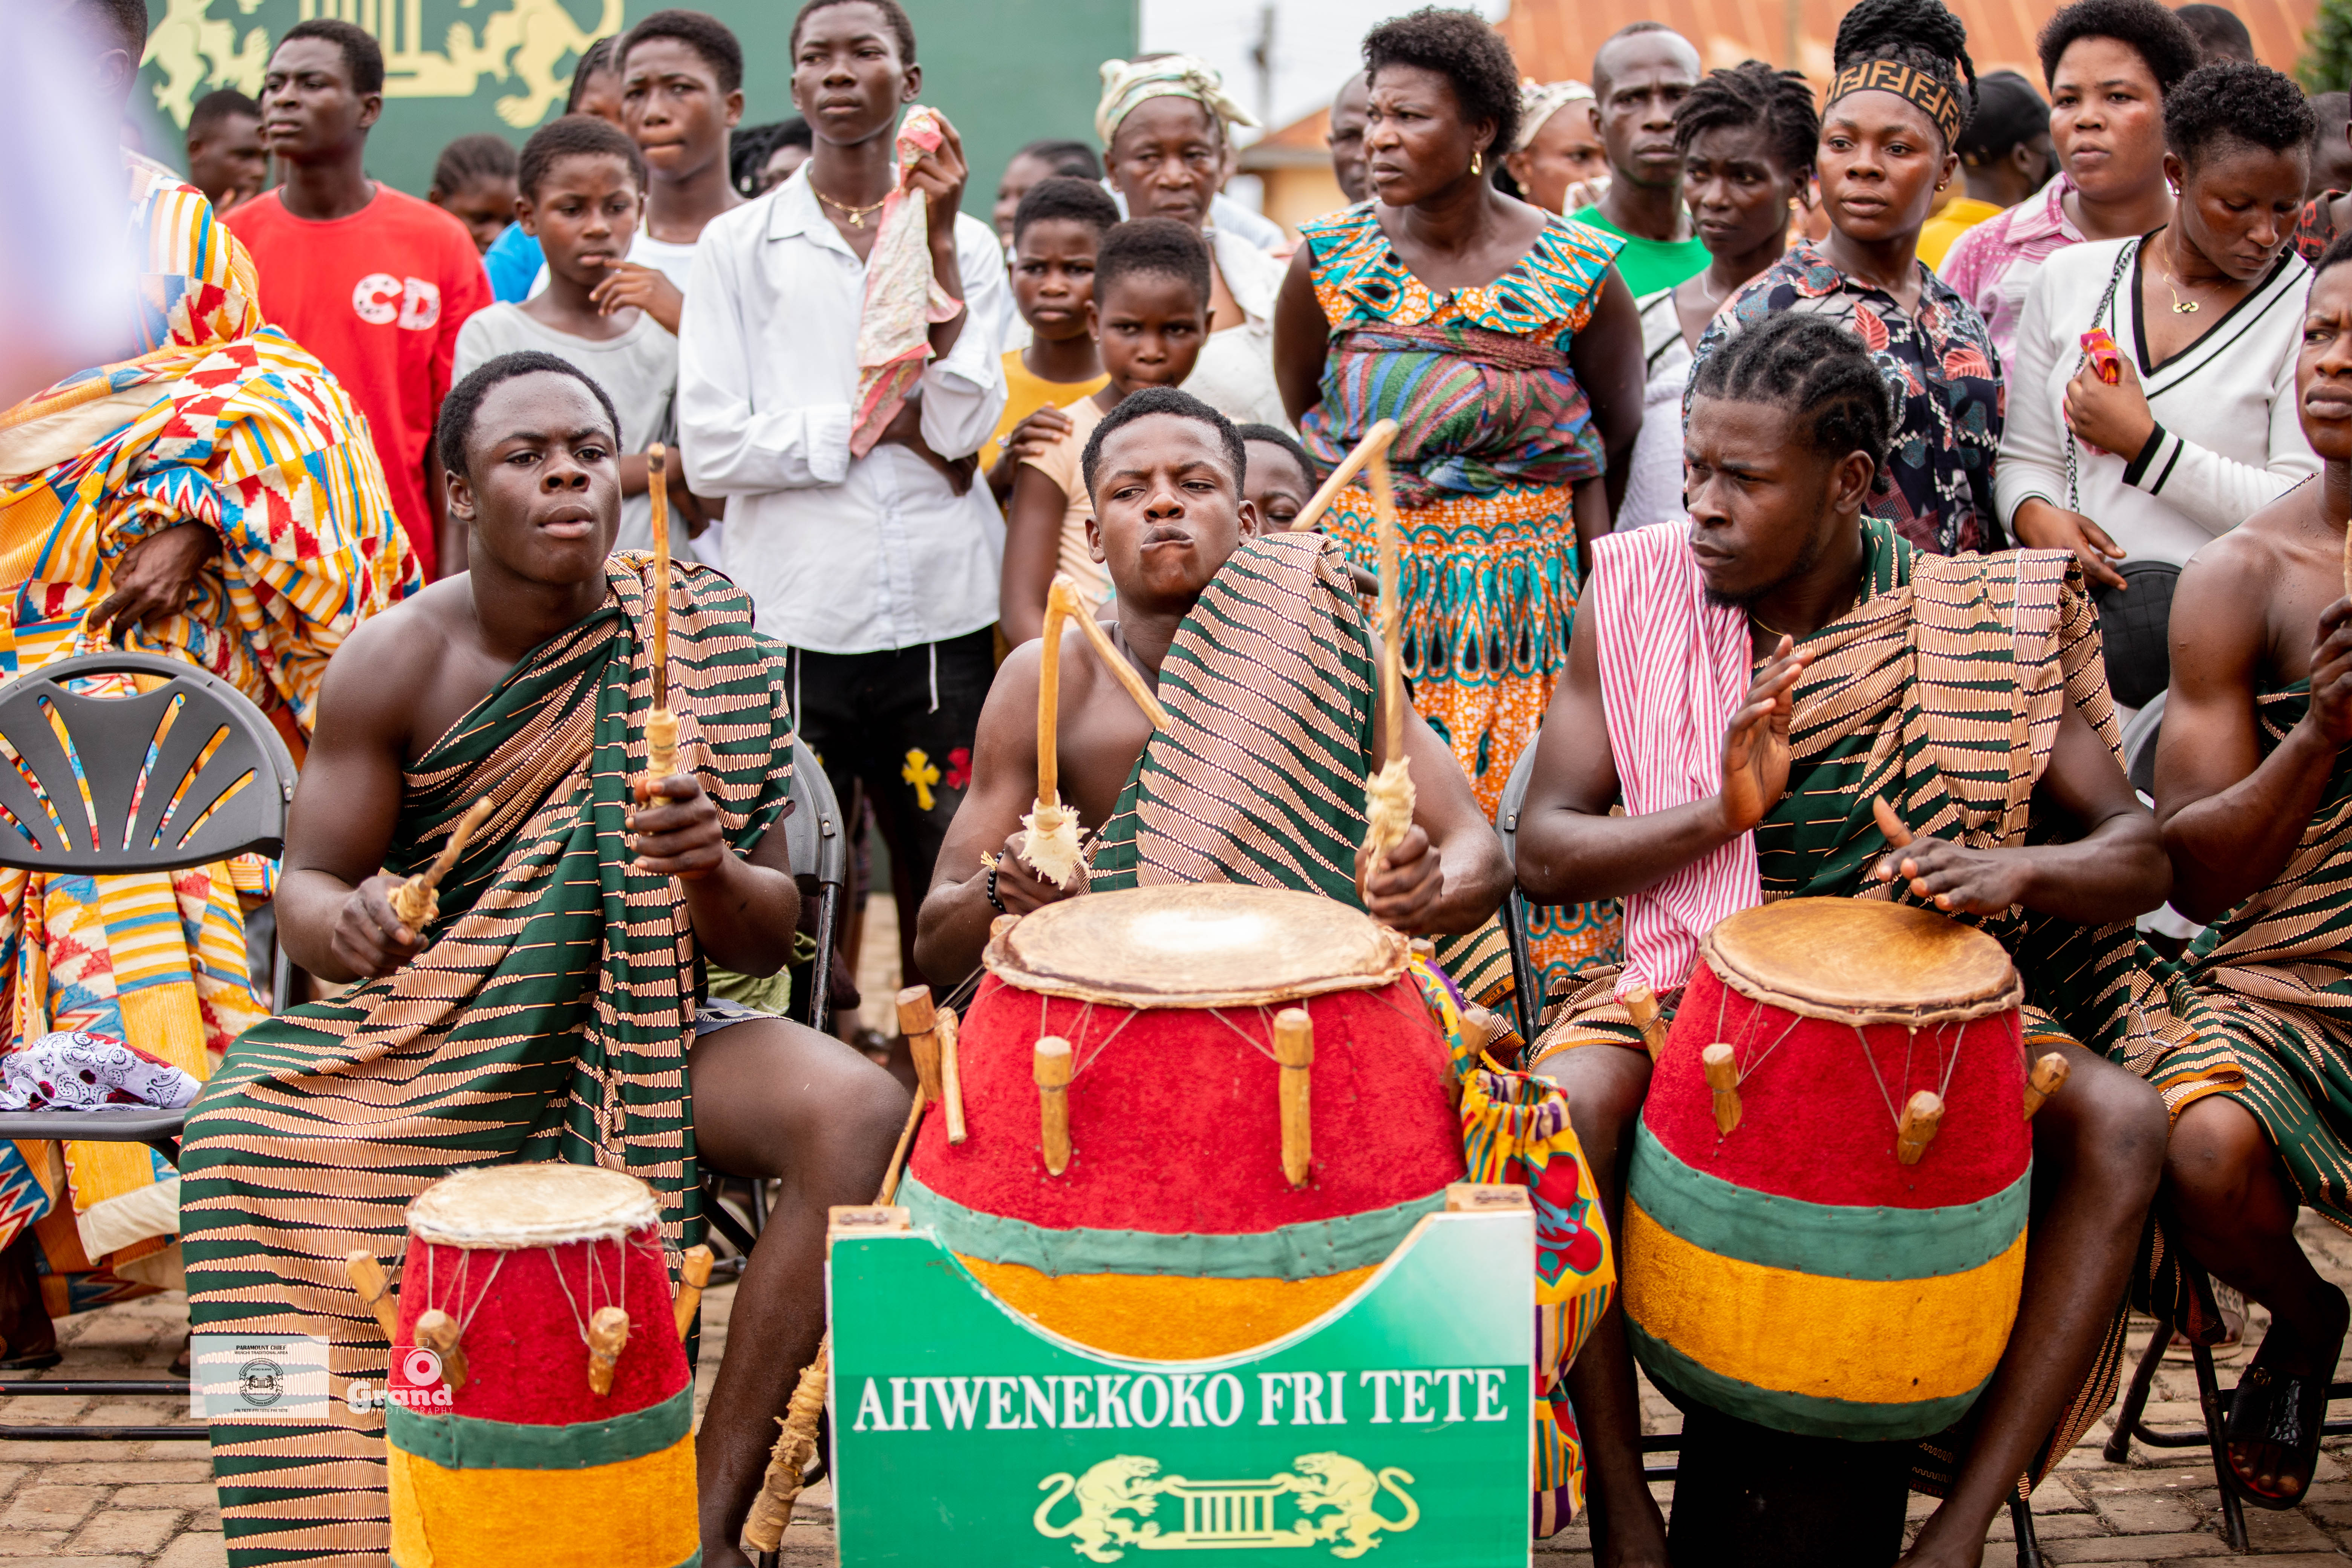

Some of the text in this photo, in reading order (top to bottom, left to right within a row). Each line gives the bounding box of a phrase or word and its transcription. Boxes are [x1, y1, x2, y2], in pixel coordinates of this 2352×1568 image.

[352, 273, 441, 331] CD
[1481, 988, 1502, 1007] RACLE
[853, 1368, 1508, 1431] AHWENEKOKO FRI TETE
